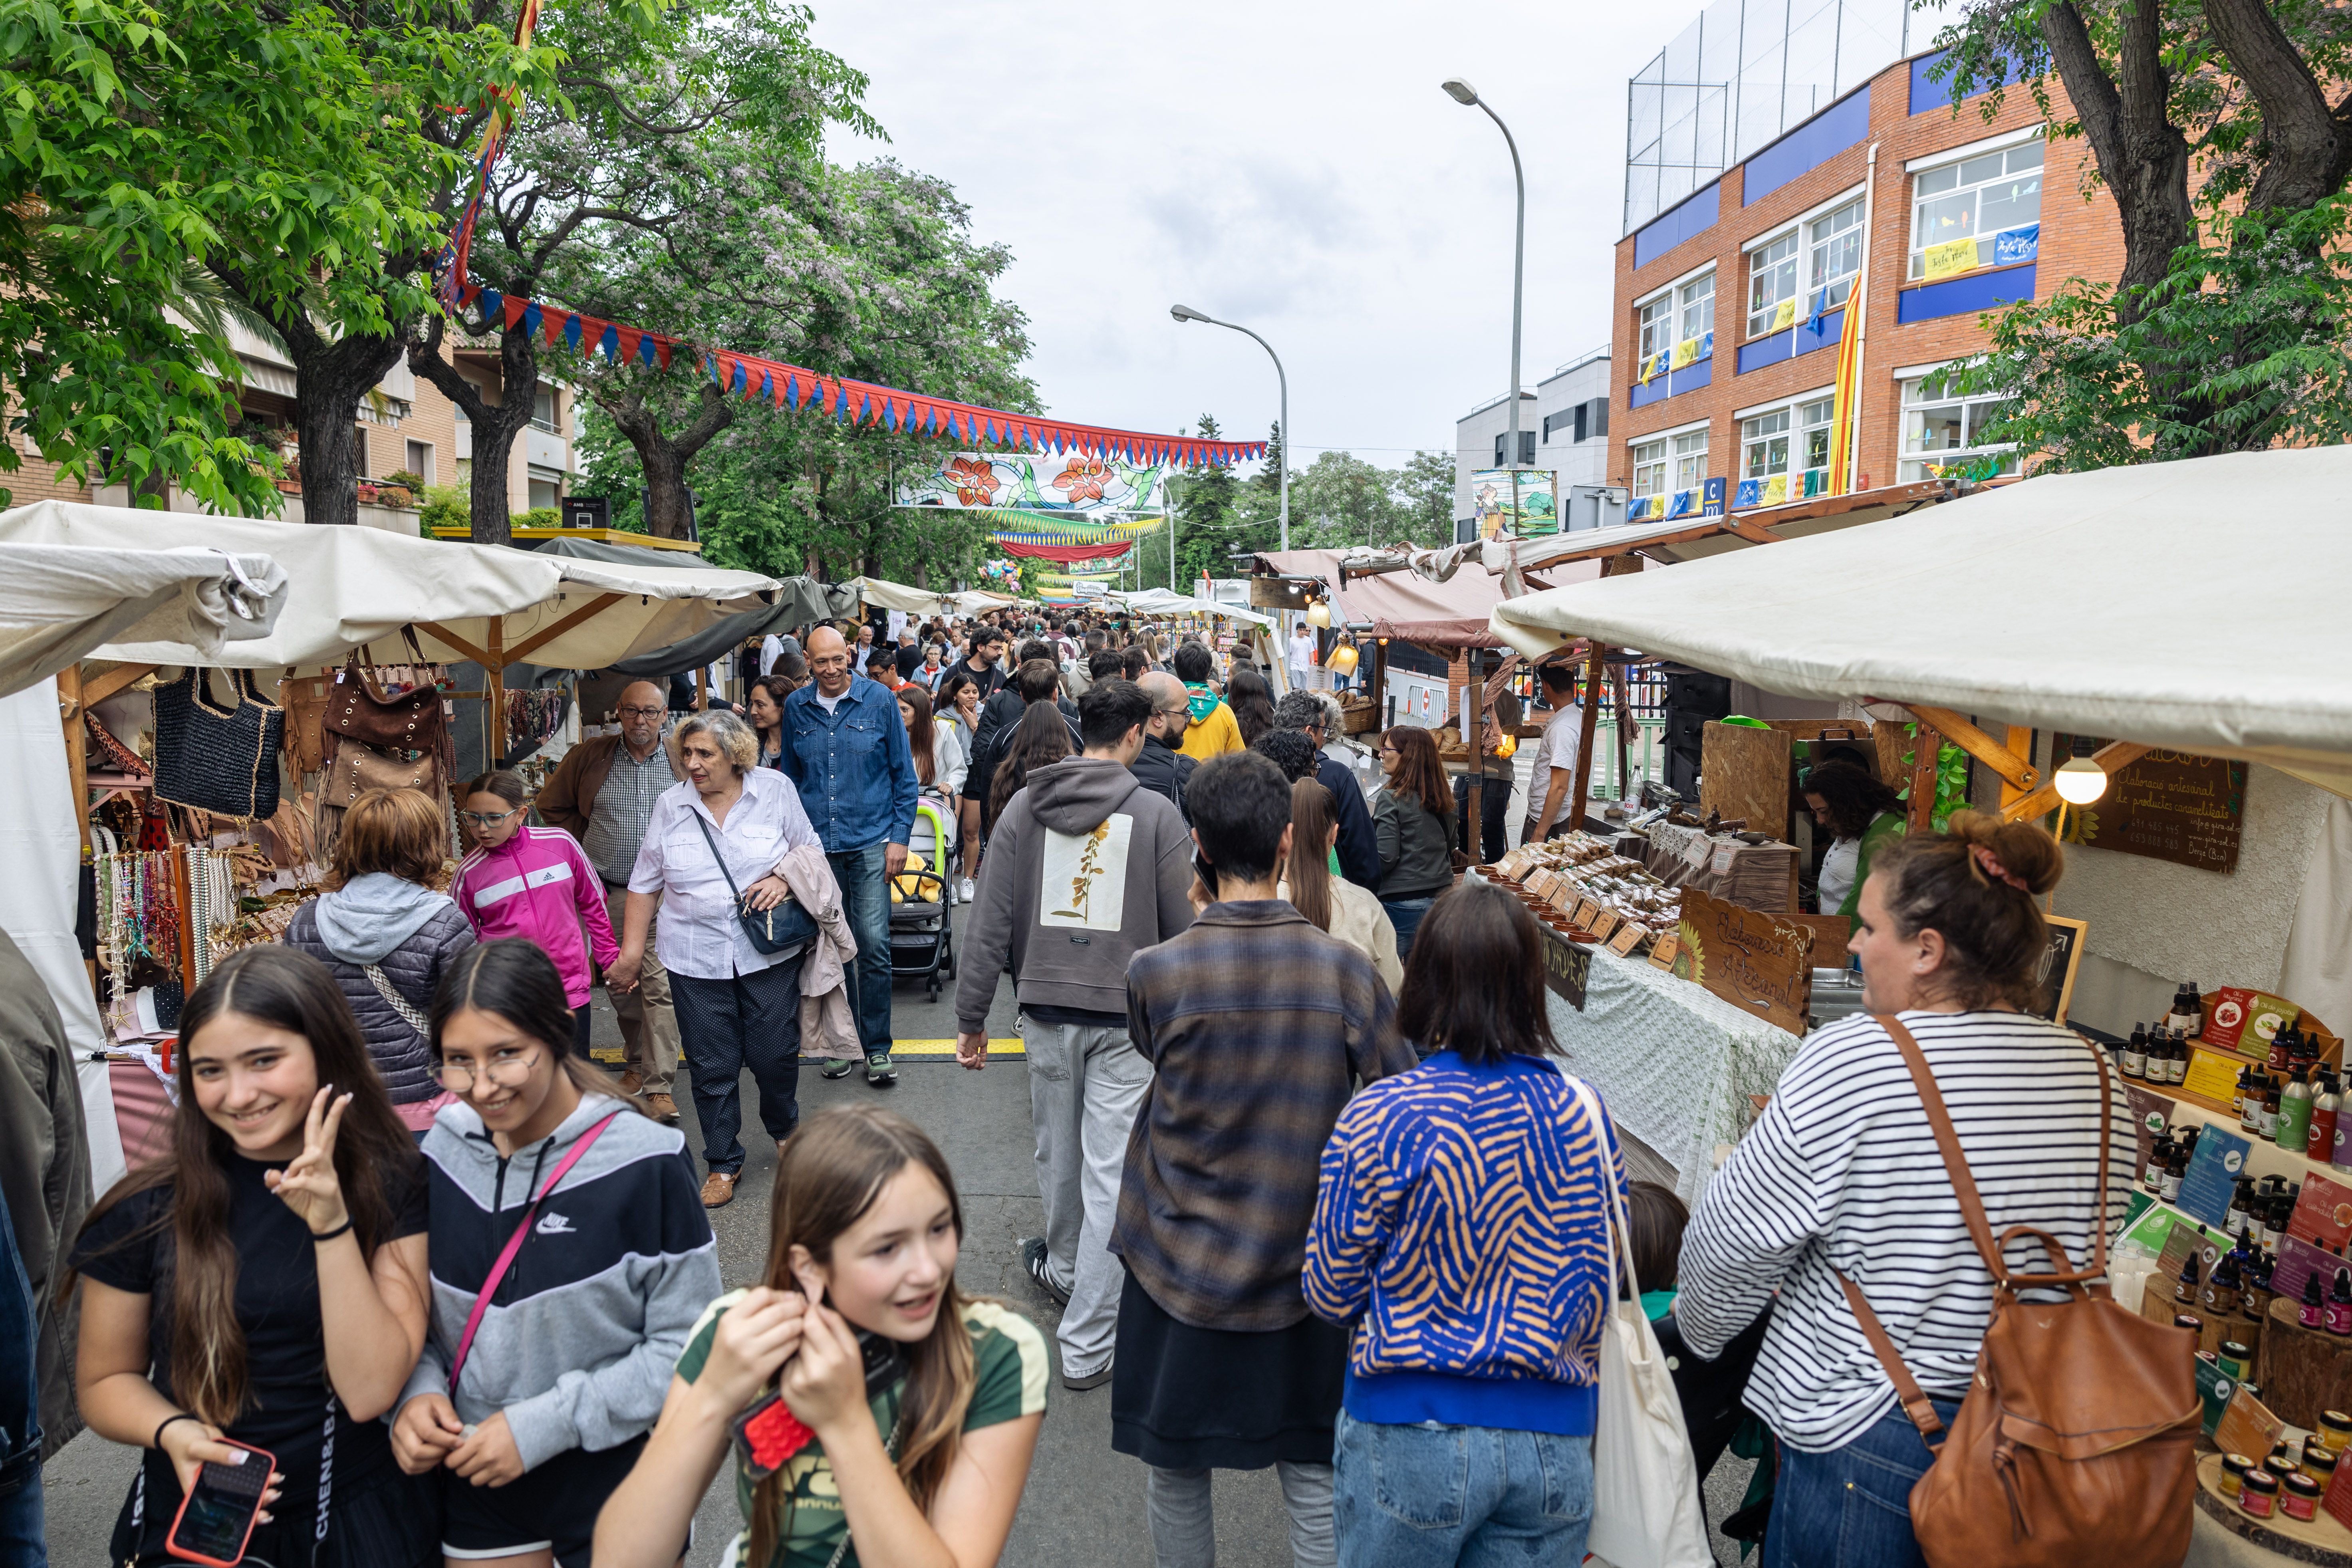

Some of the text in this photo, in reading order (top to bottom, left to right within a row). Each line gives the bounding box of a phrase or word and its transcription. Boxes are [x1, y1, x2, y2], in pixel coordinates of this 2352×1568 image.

[2118, 767, 2215, 797] Elaboració artesanal
[2116, 786, 2229, 819] de productes caramelitzats
[2132, 819, 2179, 835] 691 485 445
[2148, 835, 2161, 848] 888
[2188, 834, 2237, 848] www.gira-sol.es
[2189, 841, 2227, 862] Berga (Bcn)
[1717, 912, 1784, 957] Elaboració
[1719, 951, 1794, 1010] Artesanal
[2223, 993, 2243, 1003] Magrana
[2275, 1006, 2295, 1016] jojoba
